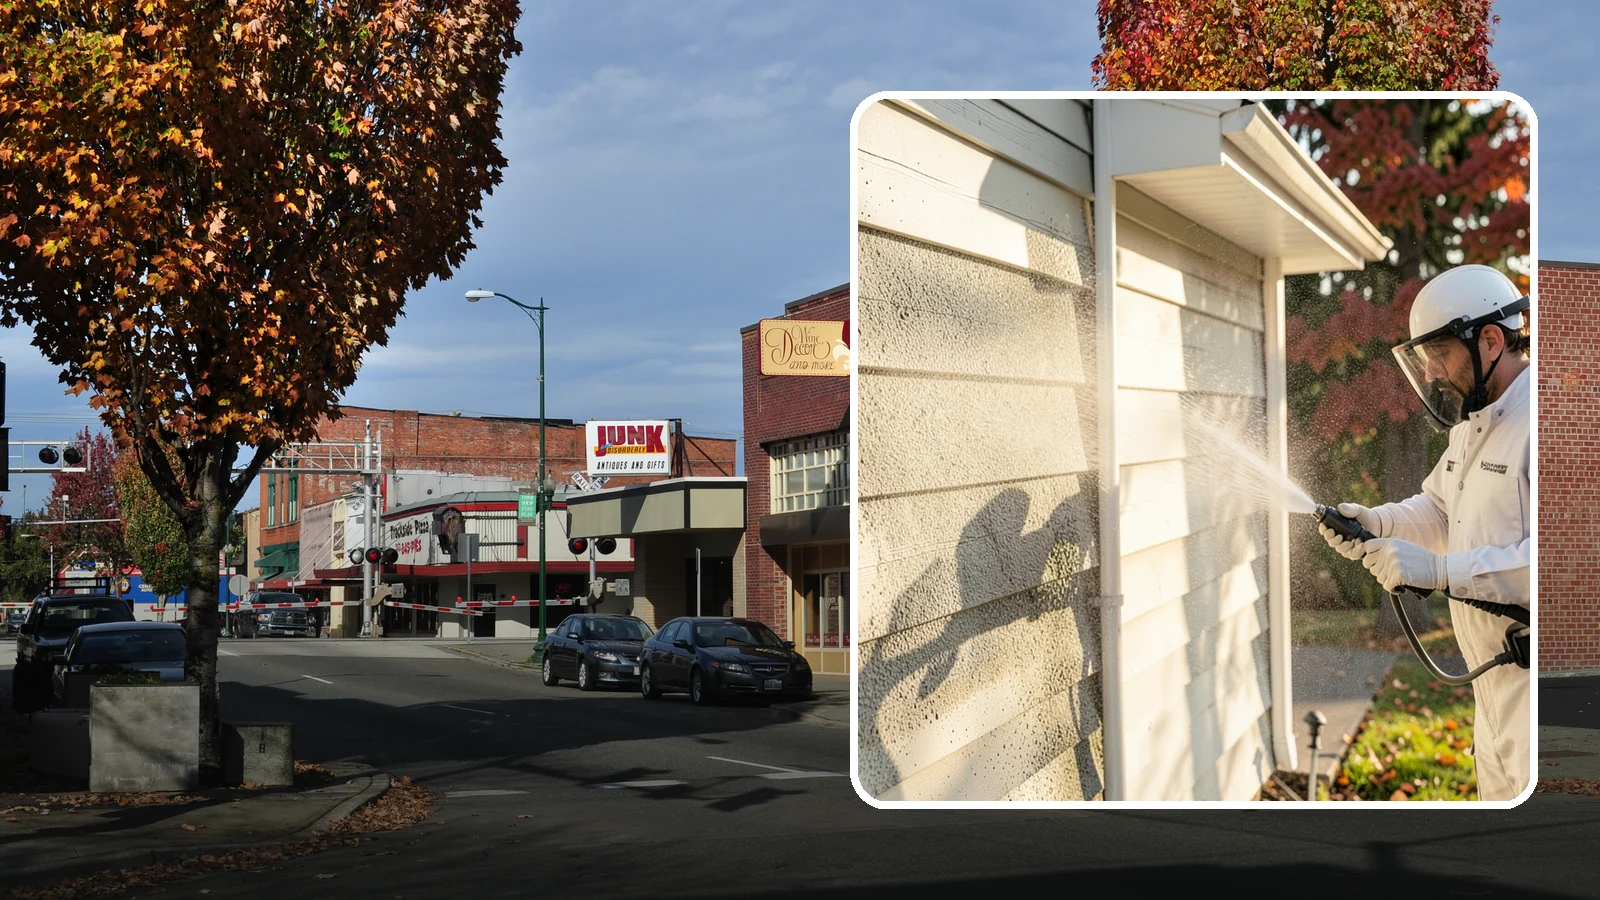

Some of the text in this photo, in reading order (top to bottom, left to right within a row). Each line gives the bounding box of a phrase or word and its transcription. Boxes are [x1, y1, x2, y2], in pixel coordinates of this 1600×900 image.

[765, 328, 831, 365] Decor
[596, 425, 665, 457] JUNK
[607, 446, 646, 454] DISORDERLY
[597, 460, 665, 470] ANTIQUES AND GIFTS
[414, 520, 429, 534] Pizza
